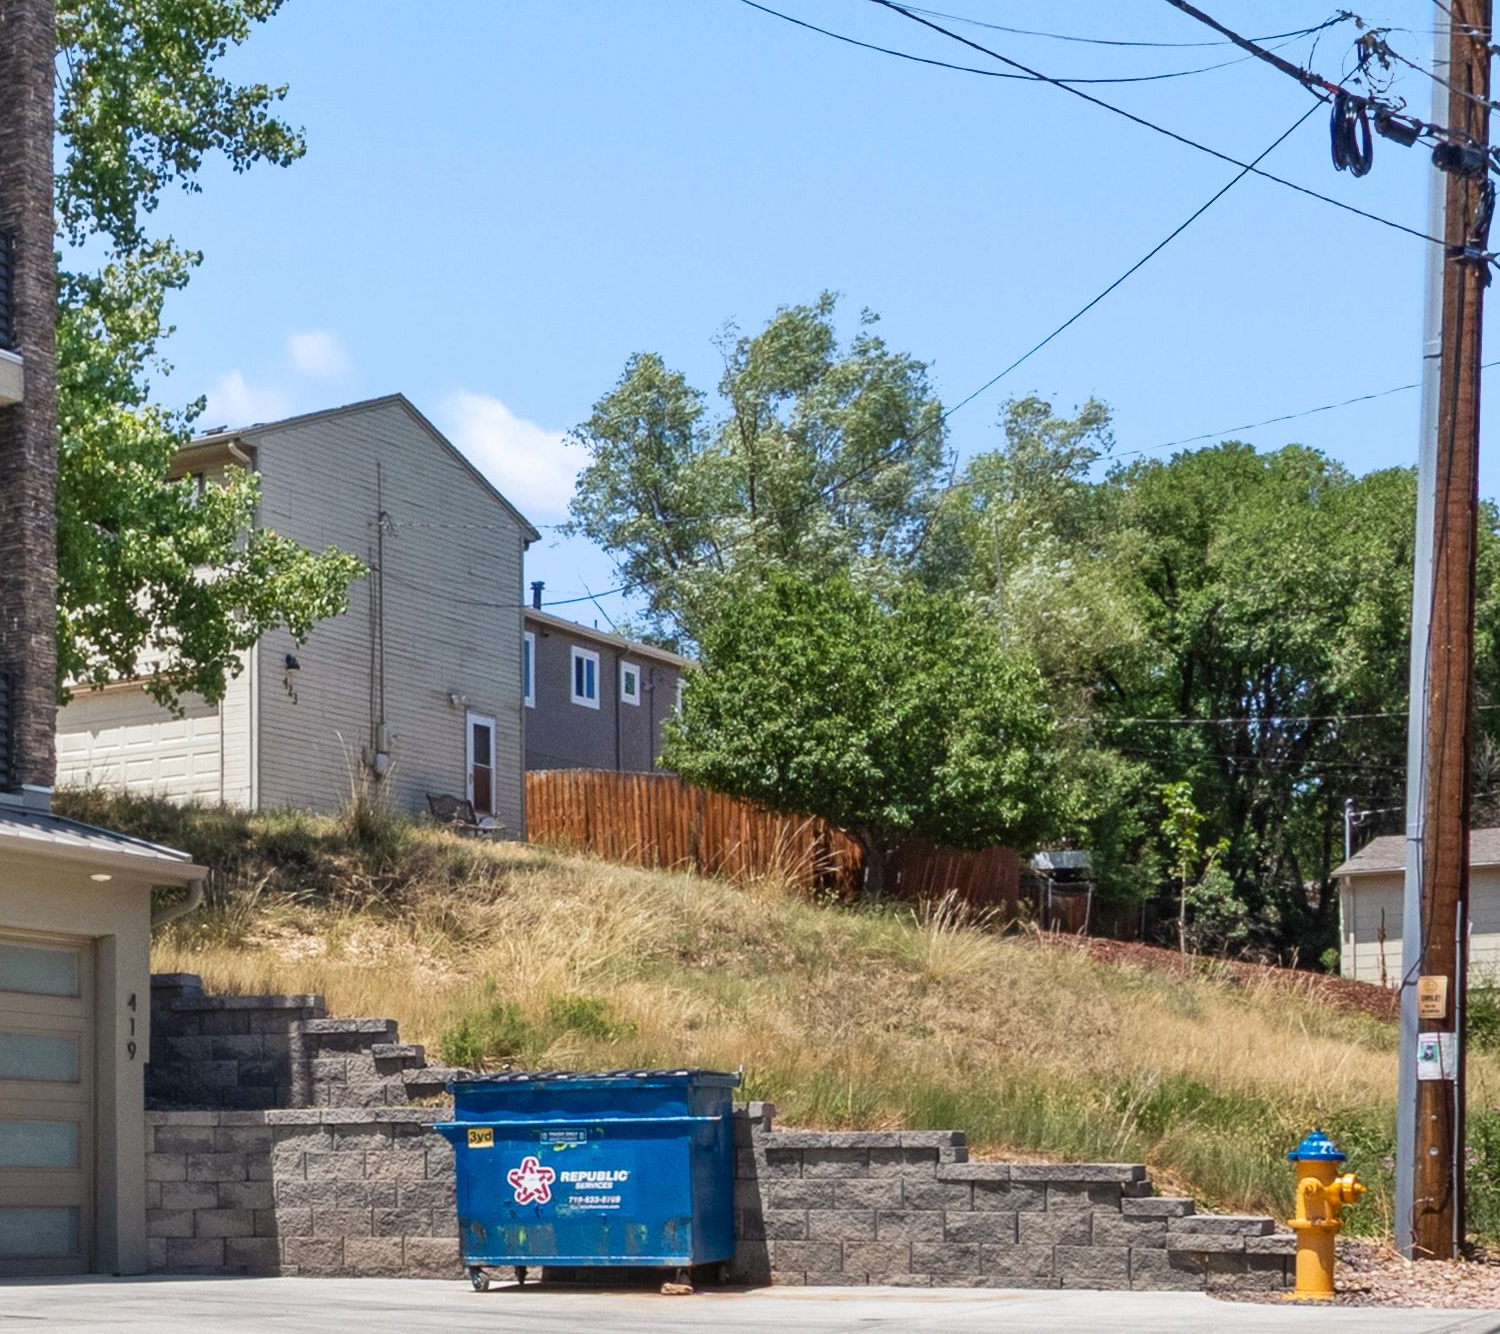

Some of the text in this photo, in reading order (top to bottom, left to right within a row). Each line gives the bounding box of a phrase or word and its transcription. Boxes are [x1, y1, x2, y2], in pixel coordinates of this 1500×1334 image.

[127, 993, 137, 1061] 419
[469, 1130, 493, 1145] 3yd
[560, 1170, 629, 1182] REPUBLIC
[575, 1181, 613, 1190] SERVICES
